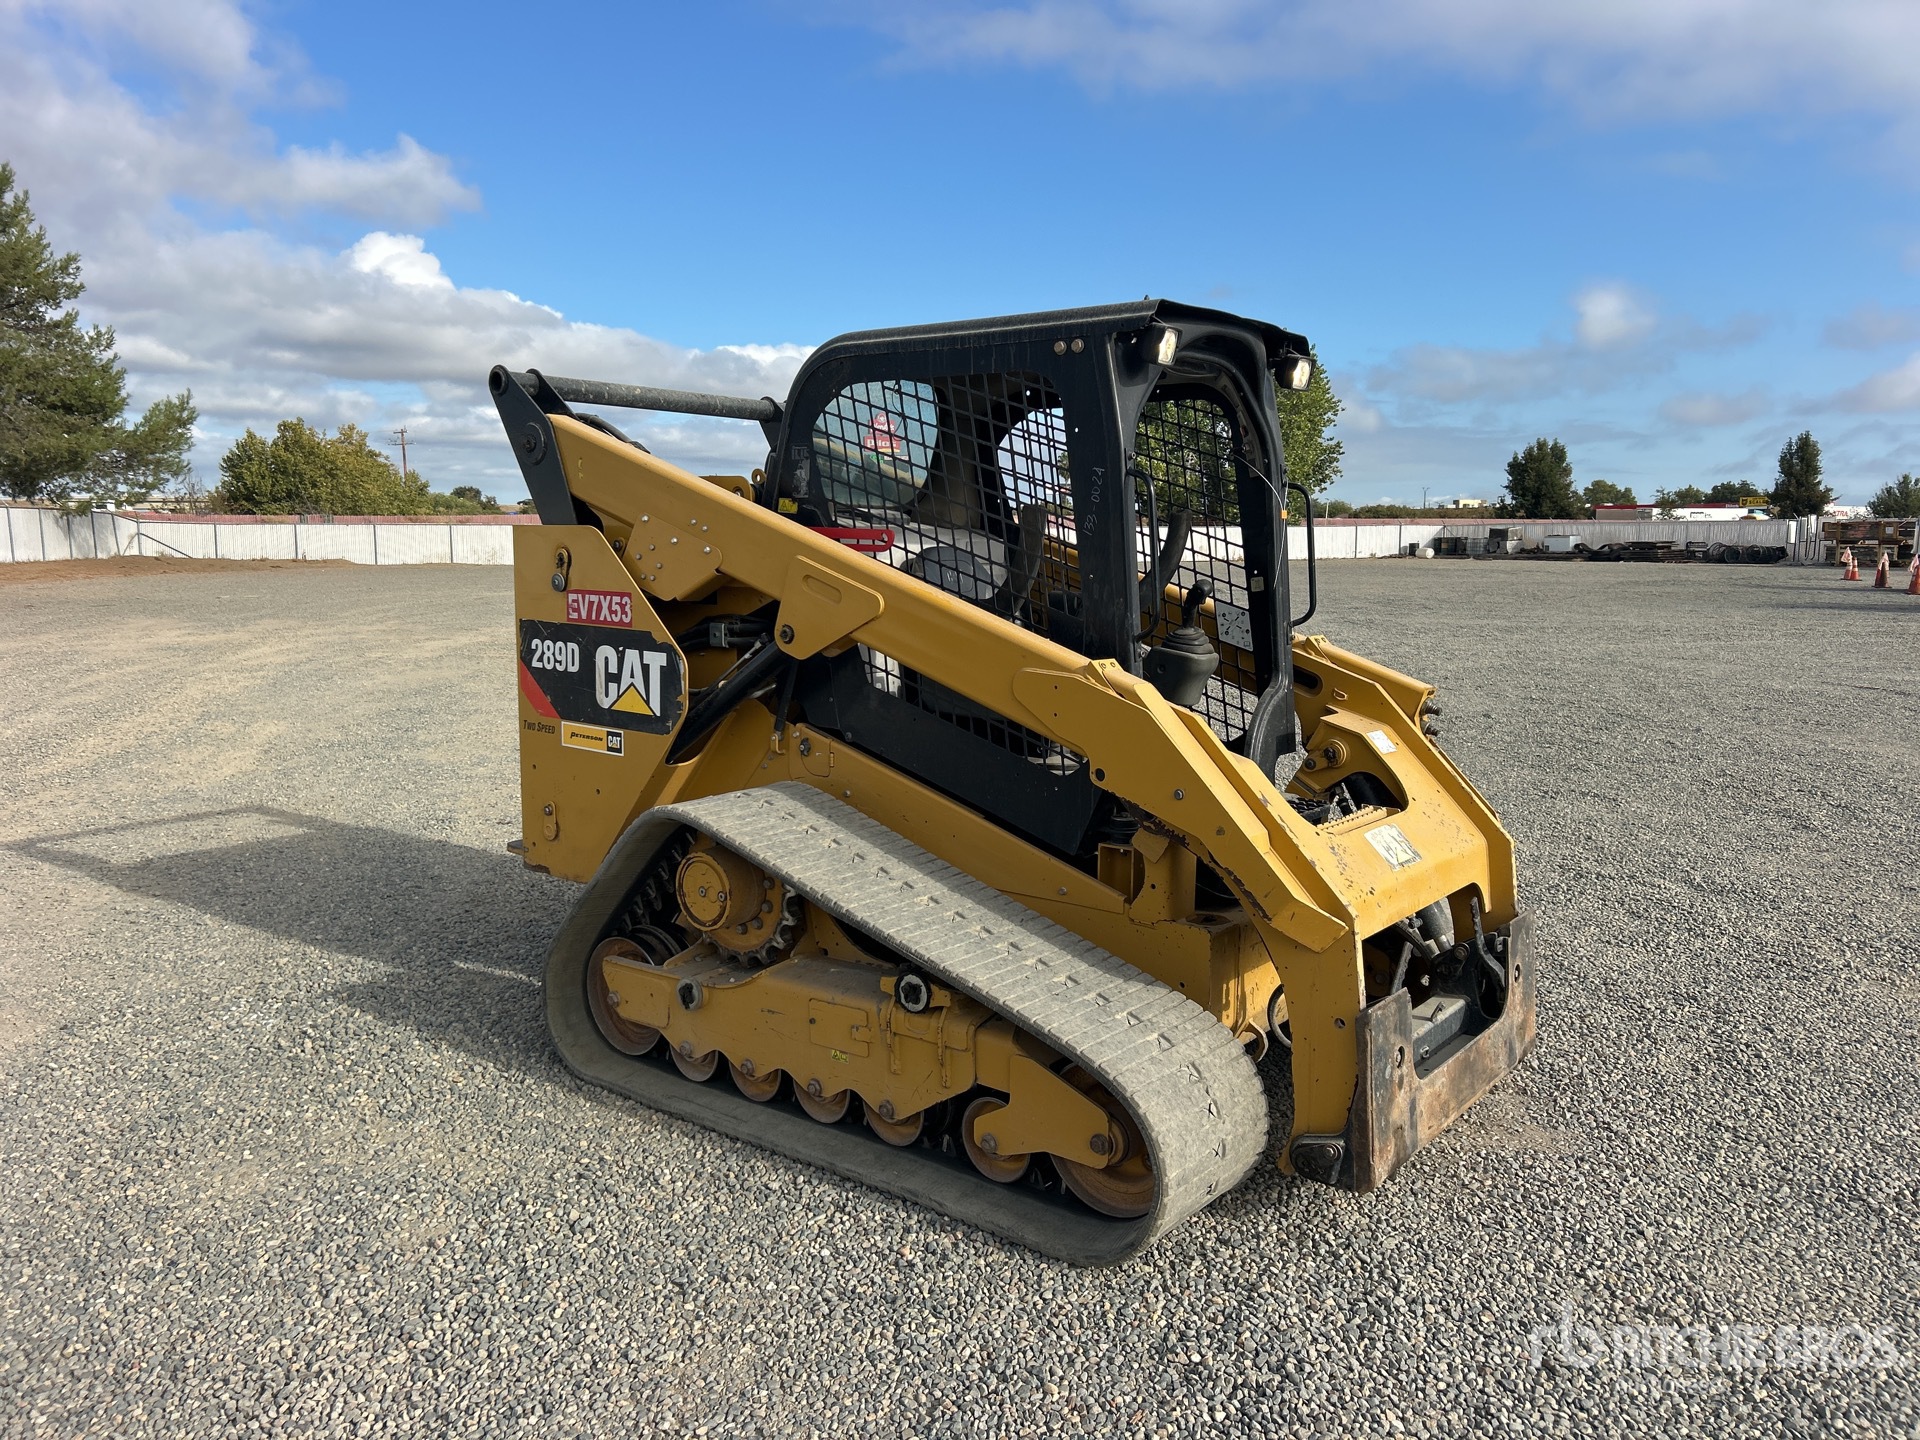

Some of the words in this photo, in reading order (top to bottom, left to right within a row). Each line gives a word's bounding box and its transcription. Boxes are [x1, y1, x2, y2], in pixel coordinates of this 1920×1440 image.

[568, 593, 632, 623] EV7X53
[531, 638, 580, 673] 289D
[595, 645, 667, 717] CAT
[570, 731, 604, 742] PETERSON
[608, 735, 621, 749] CAT
